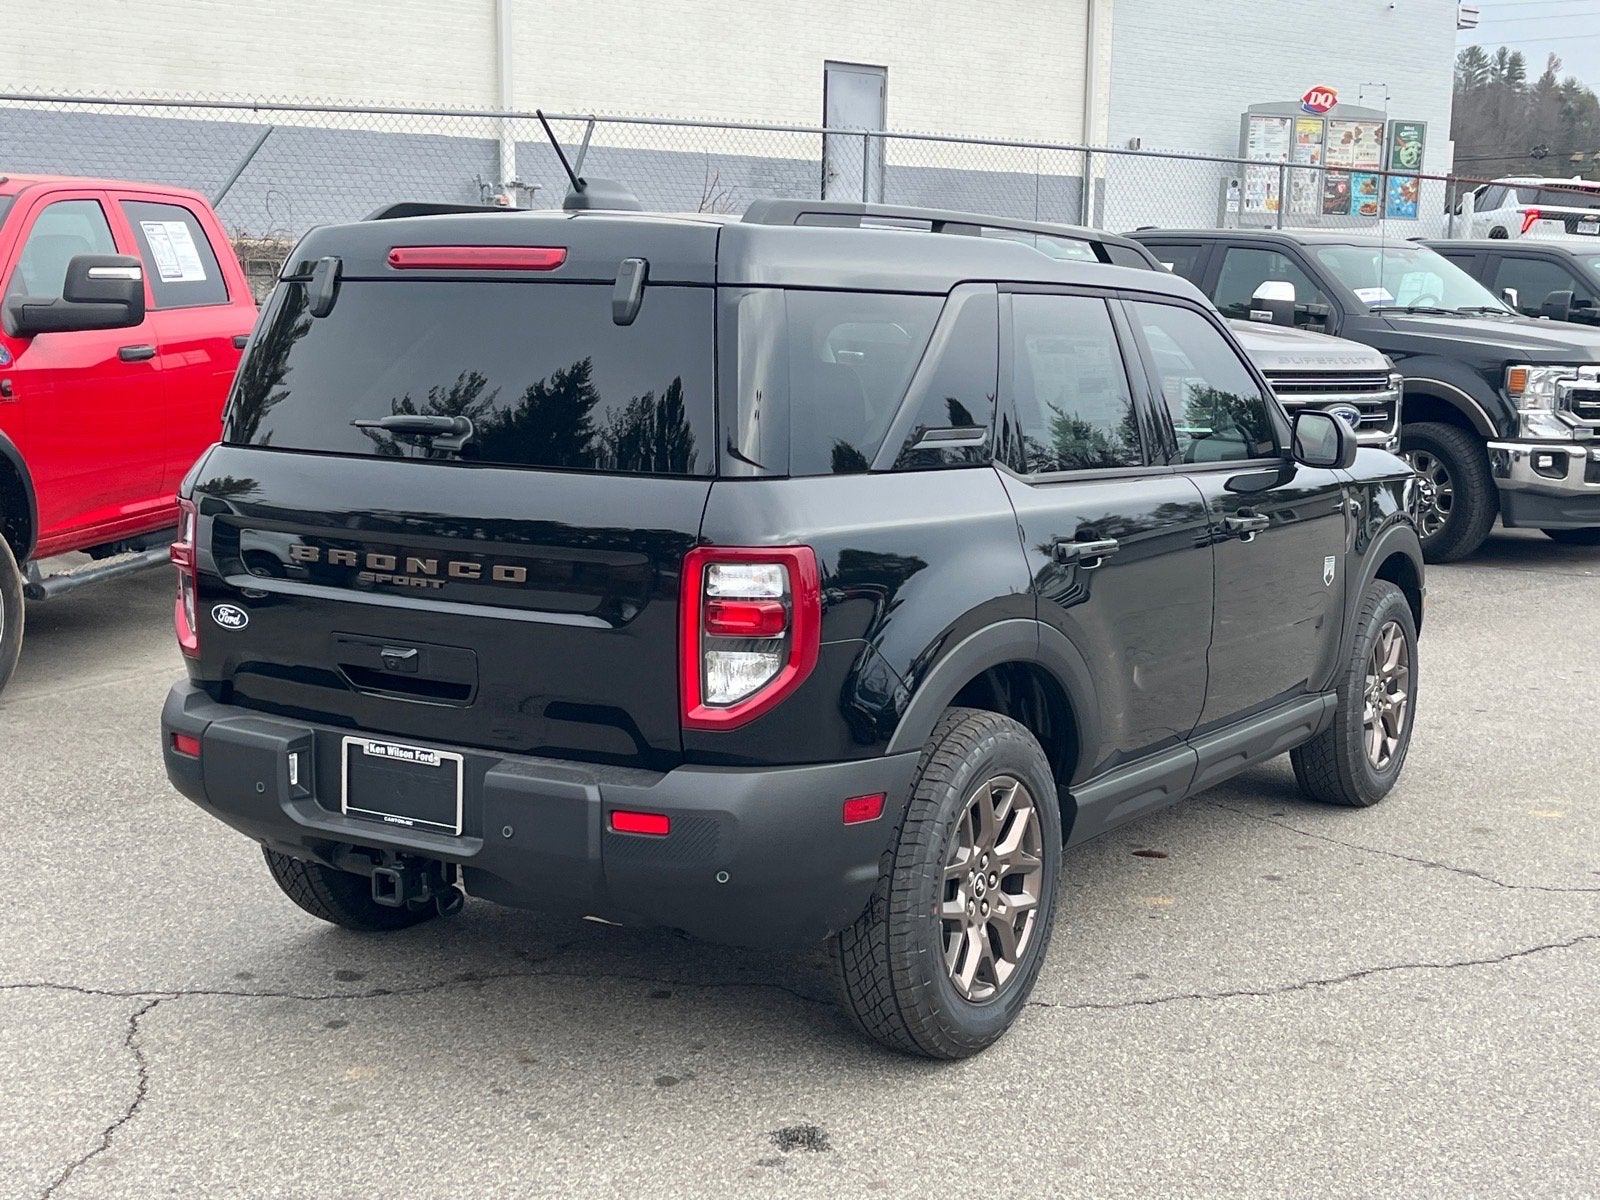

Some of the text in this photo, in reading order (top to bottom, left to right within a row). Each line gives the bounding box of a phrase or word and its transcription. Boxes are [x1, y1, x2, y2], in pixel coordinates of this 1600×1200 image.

[1308, 91, 1333, 109] DQ
[289, 544, 528, 583] BRONCO
[358, 571, 448, 589] SPORT
[217, 606, 241, 625] Ford
[369, 742, 434, 763] Ken Wilson Ford
